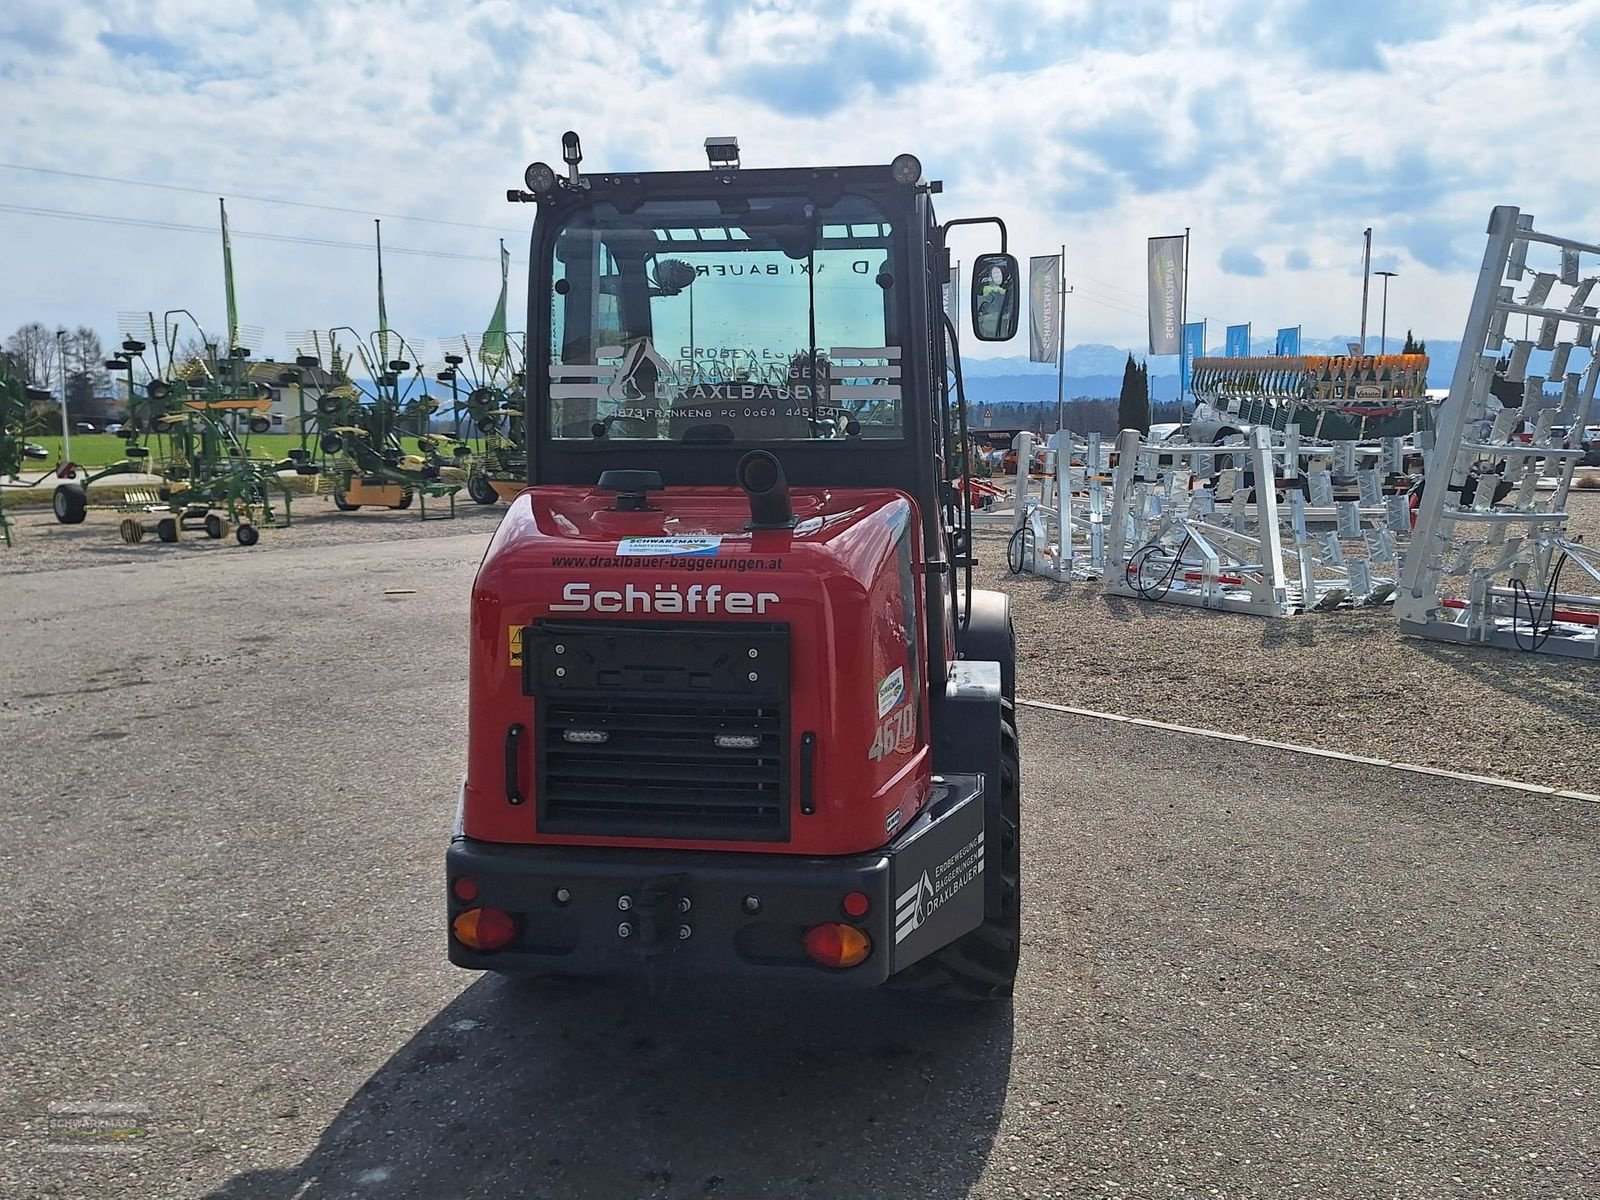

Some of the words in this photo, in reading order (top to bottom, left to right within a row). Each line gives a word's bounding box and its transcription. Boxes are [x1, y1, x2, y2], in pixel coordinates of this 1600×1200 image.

[654, 384, 826, 400] DRAXLBAUER
[646, 407, 737, 418] FRANKENBRG
[551, 555, 783, 571] www.draxlbauer-baggerungen.at
[549, 582, 780, 614] Schäffer
[868, 703, 913, 762] 4670
[935, 838, 978, 878] ERDBEWEGUNG
[935, 852, 978, 893] BAGGERUNGEN
[926, 864, 978, 917] DRAXLBAUER
